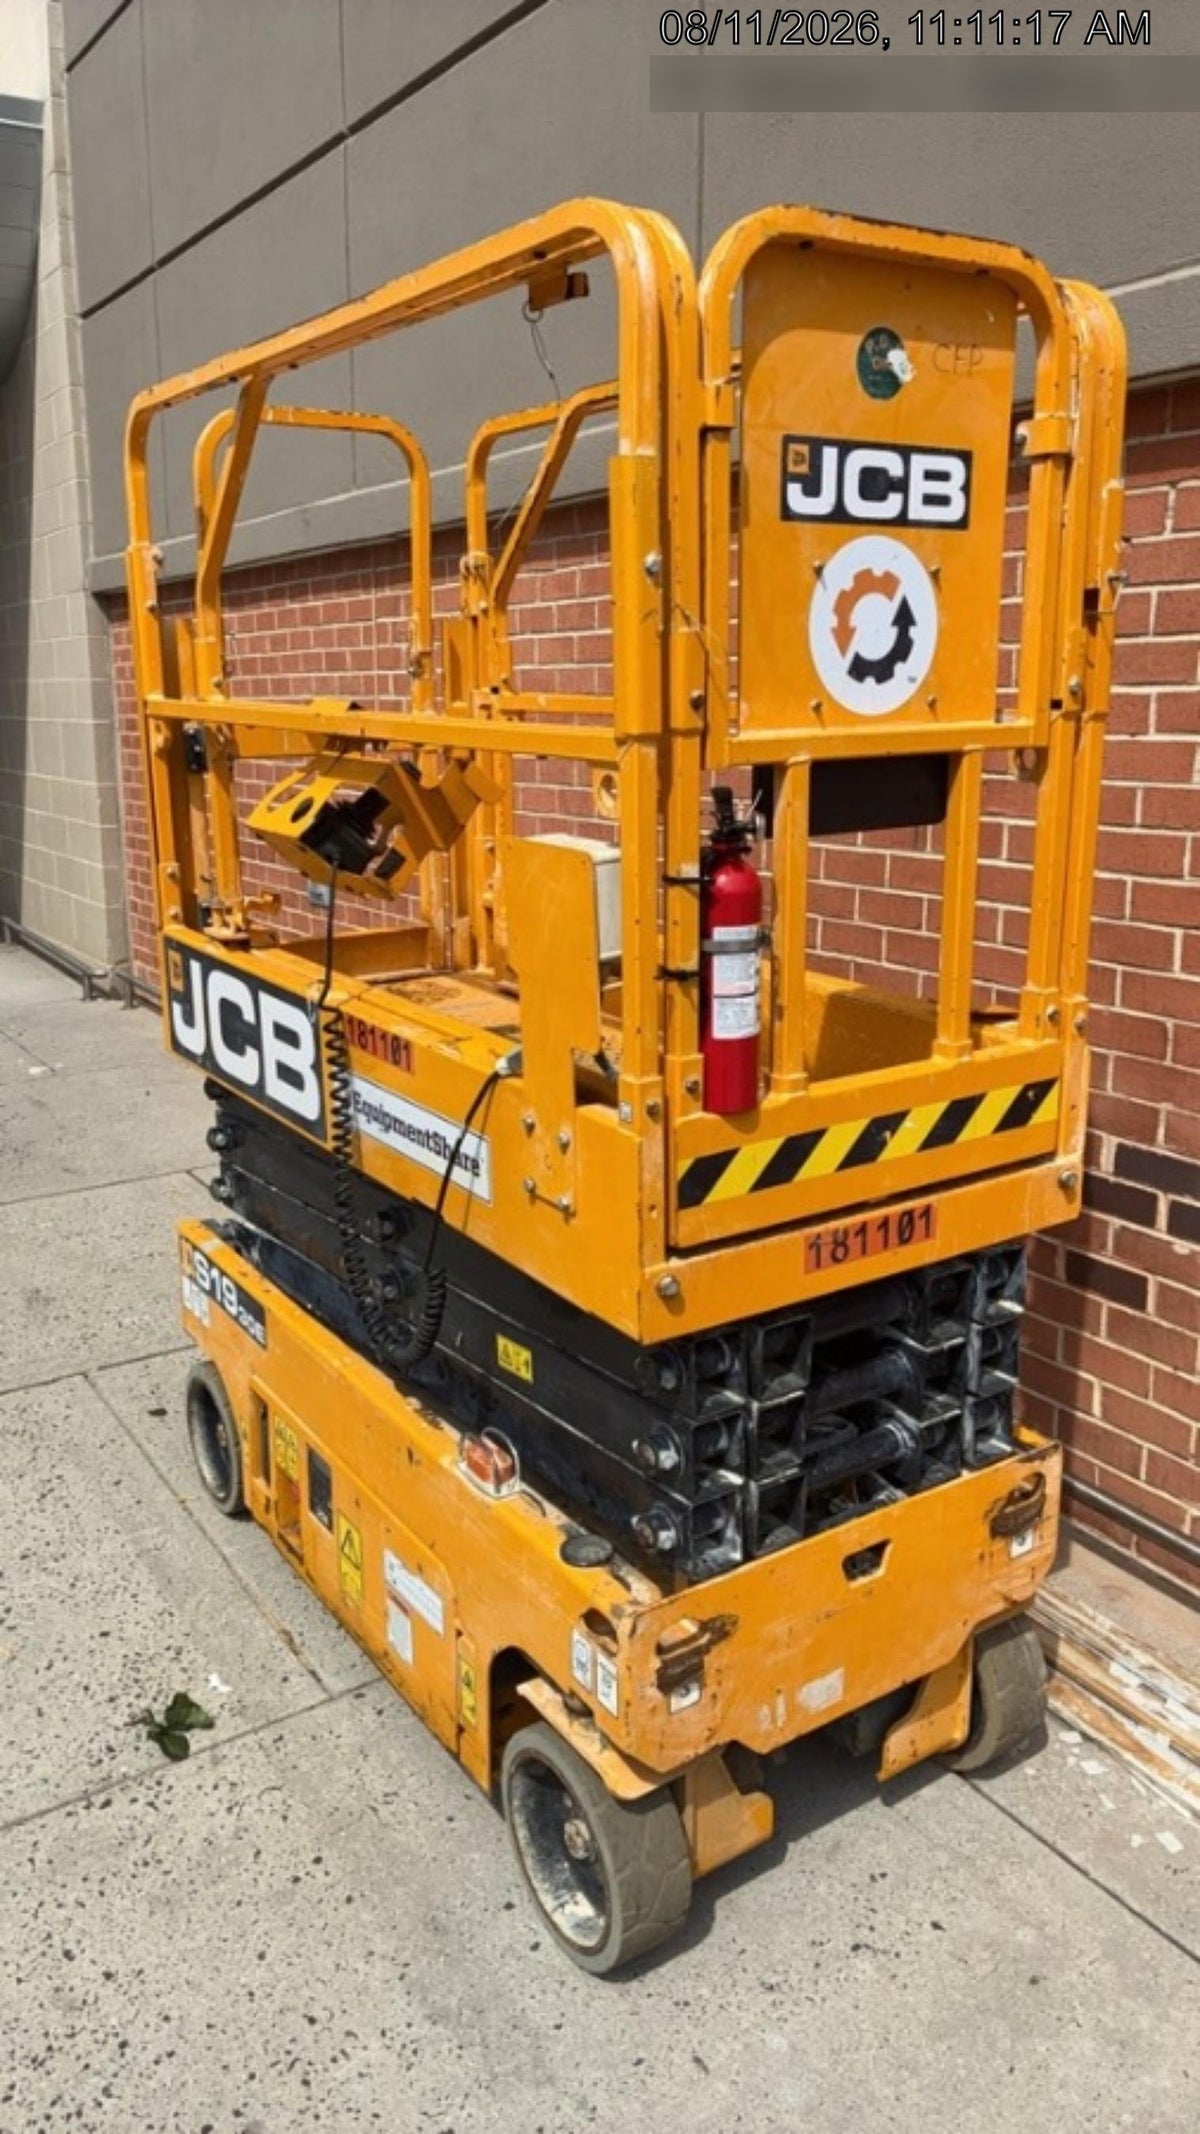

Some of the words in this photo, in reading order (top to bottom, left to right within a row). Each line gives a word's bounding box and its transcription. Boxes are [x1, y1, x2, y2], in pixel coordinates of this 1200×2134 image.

[786, 445, 967, 523] JCB
[172, 957, 321, 1121] JCB
[344, 1012, 412, 1072] 181101
[808, 1203, 932, 1270] 181101
